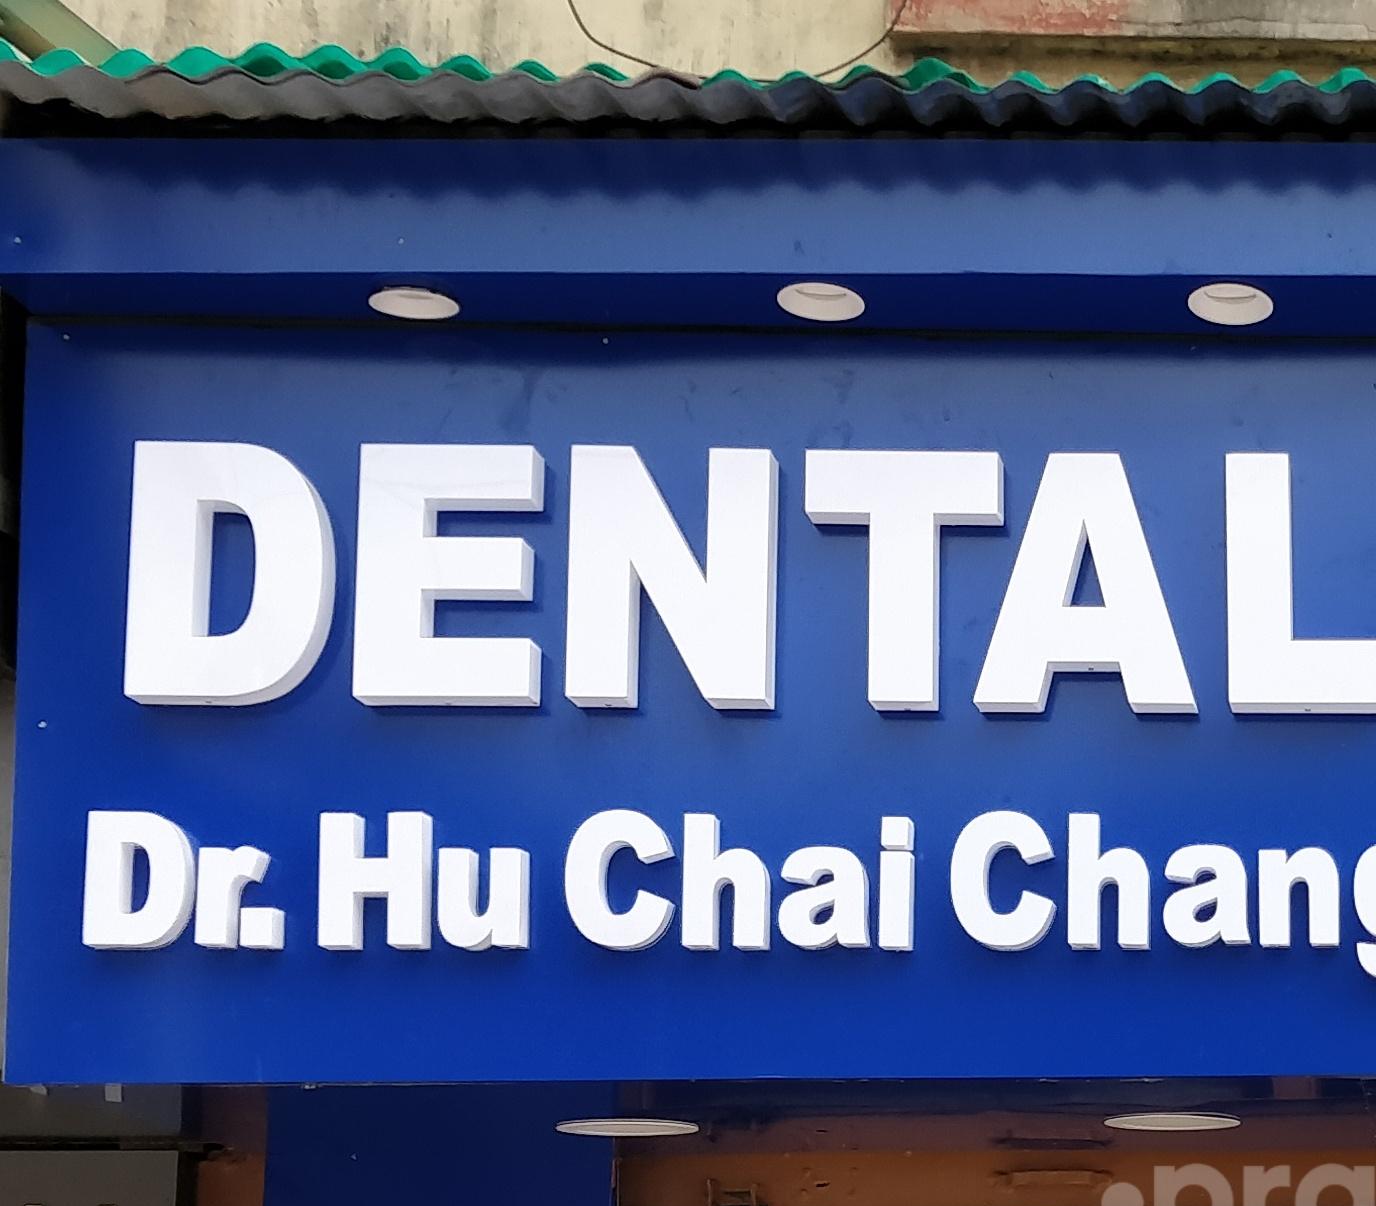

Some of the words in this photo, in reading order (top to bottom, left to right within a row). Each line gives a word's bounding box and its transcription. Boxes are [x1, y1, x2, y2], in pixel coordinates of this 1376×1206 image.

[83, 810, 285, 951] Dr.
[317, 811, 531, 950] Hu
[563, 809, 915, 951] Chai
